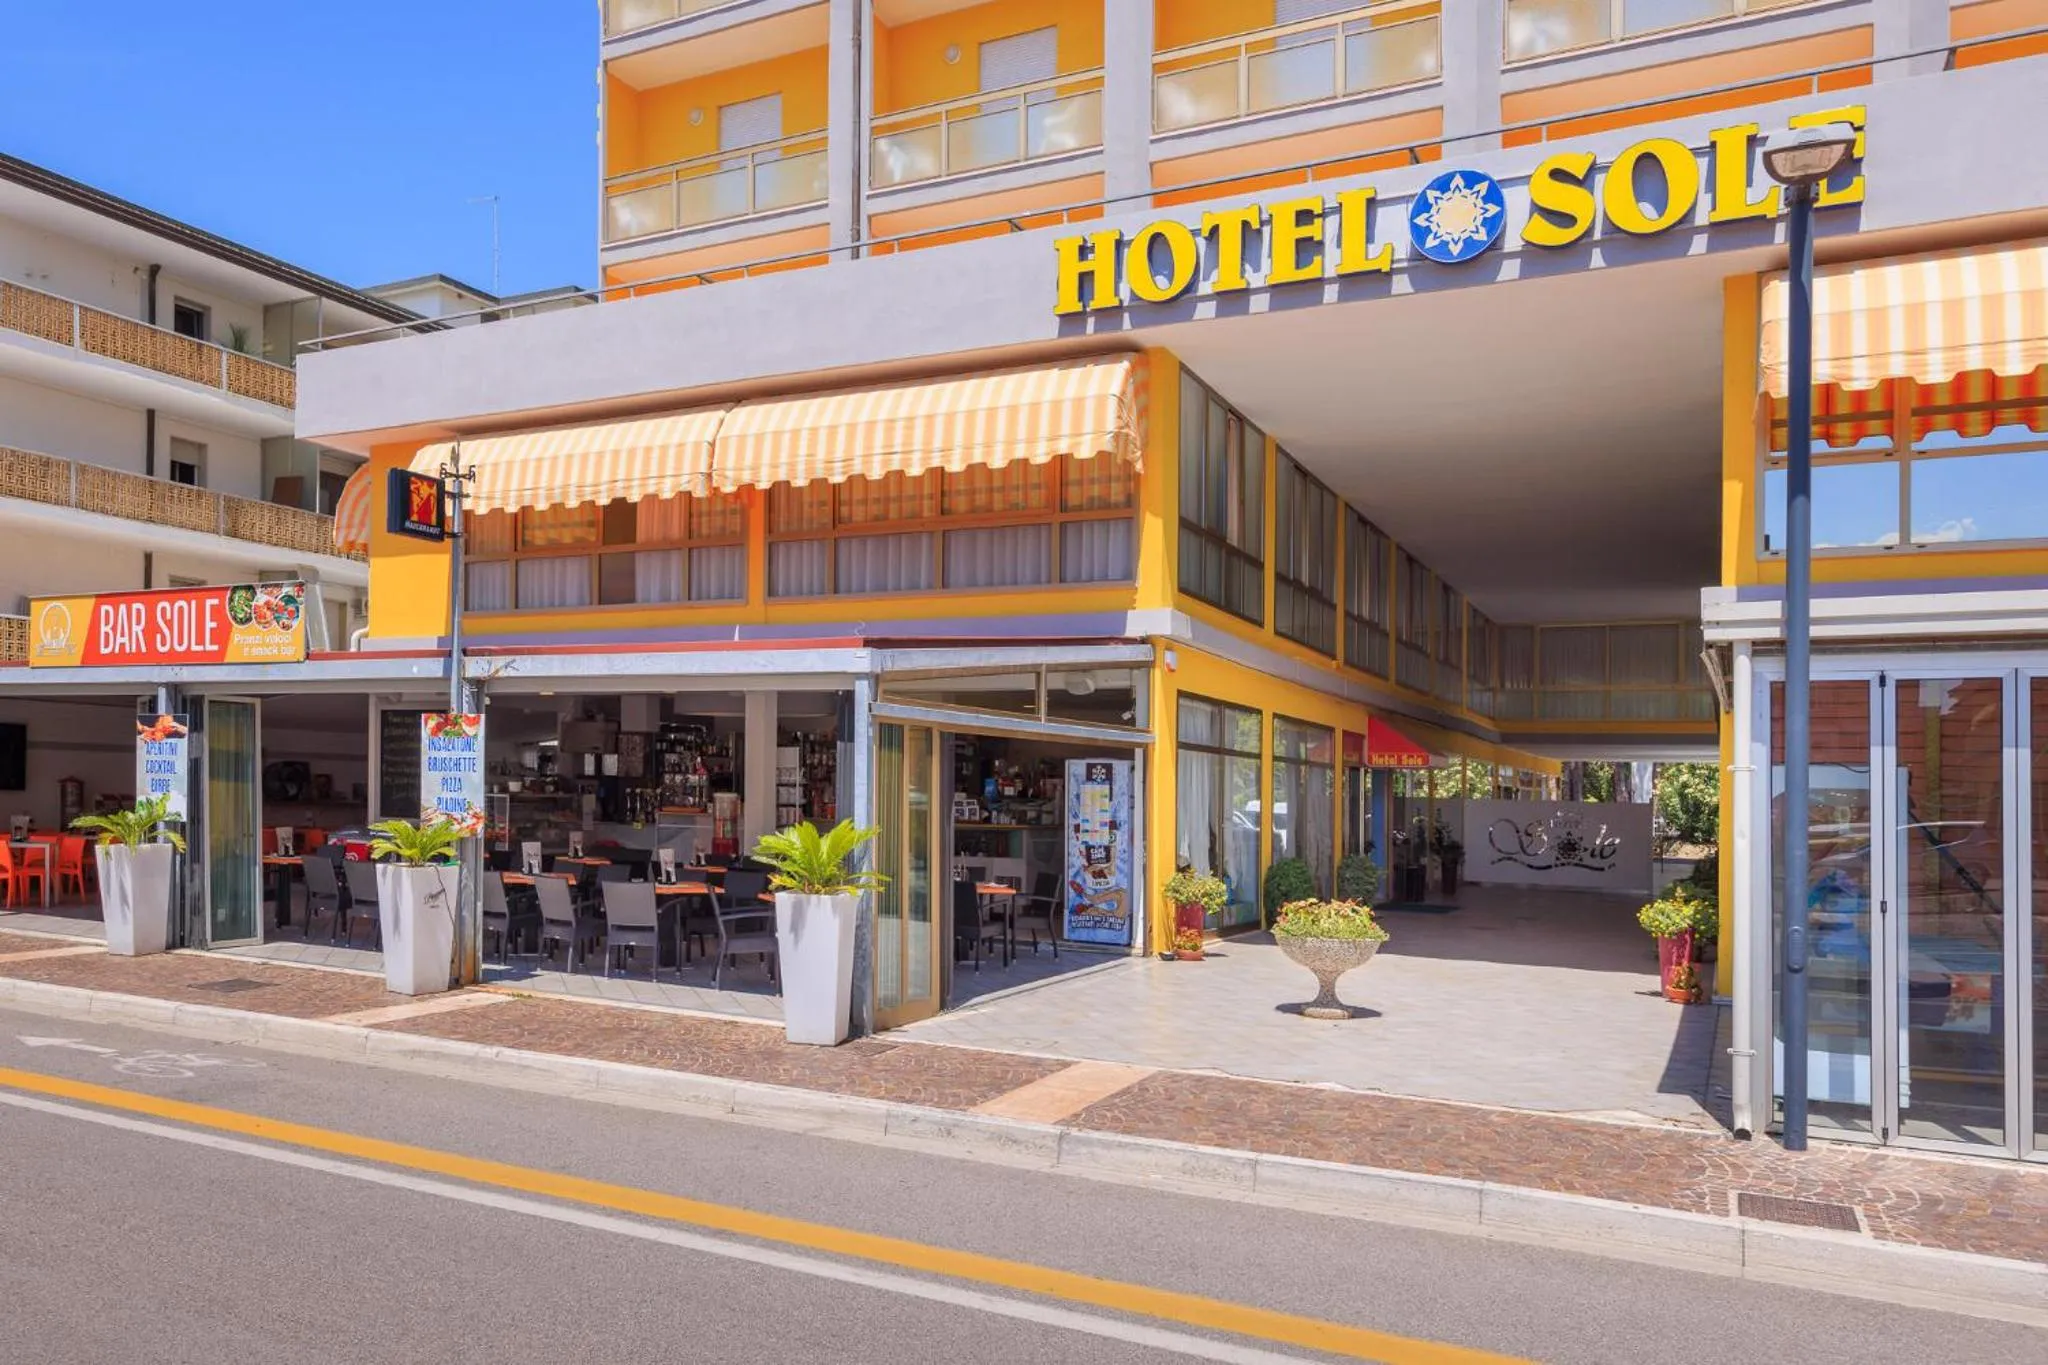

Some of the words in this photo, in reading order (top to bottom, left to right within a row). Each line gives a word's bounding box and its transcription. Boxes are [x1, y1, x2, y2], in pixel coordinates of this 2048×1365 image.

[1054, 187, 1393, 315] HOTEL
[99, 603, 148, 655] BAR
[155, 598, 220, 653] SOLE
[145, 760, 177, 774] COCKTAIL
[428, 757, 477, 772] BRUSCHETTE
[441, 777, 462, 792] PIZZA
